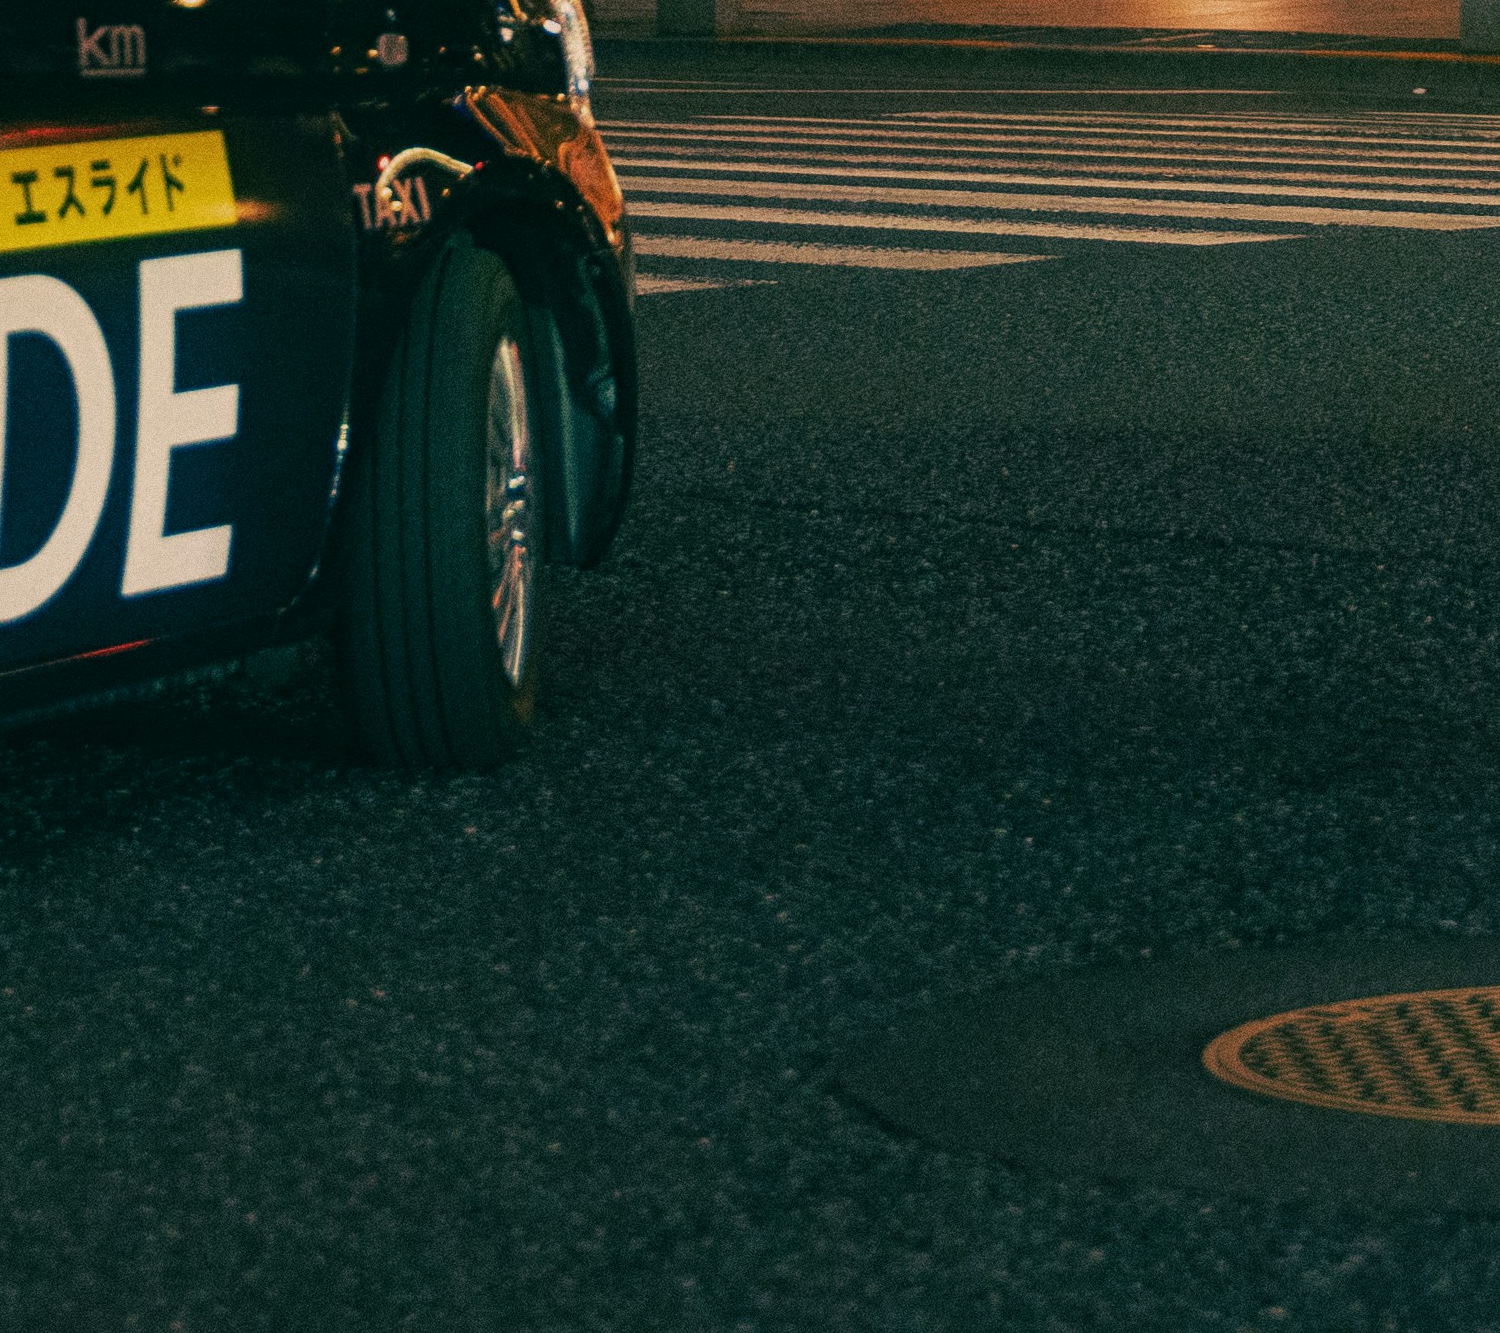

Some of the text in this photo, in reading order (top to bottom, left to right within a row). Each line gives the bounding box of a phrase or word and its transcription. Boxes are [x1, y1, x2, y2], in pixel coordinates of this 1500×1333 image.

[10, 153, 185, 226] エスライド
[352, 176, 432, 230] TAXI
